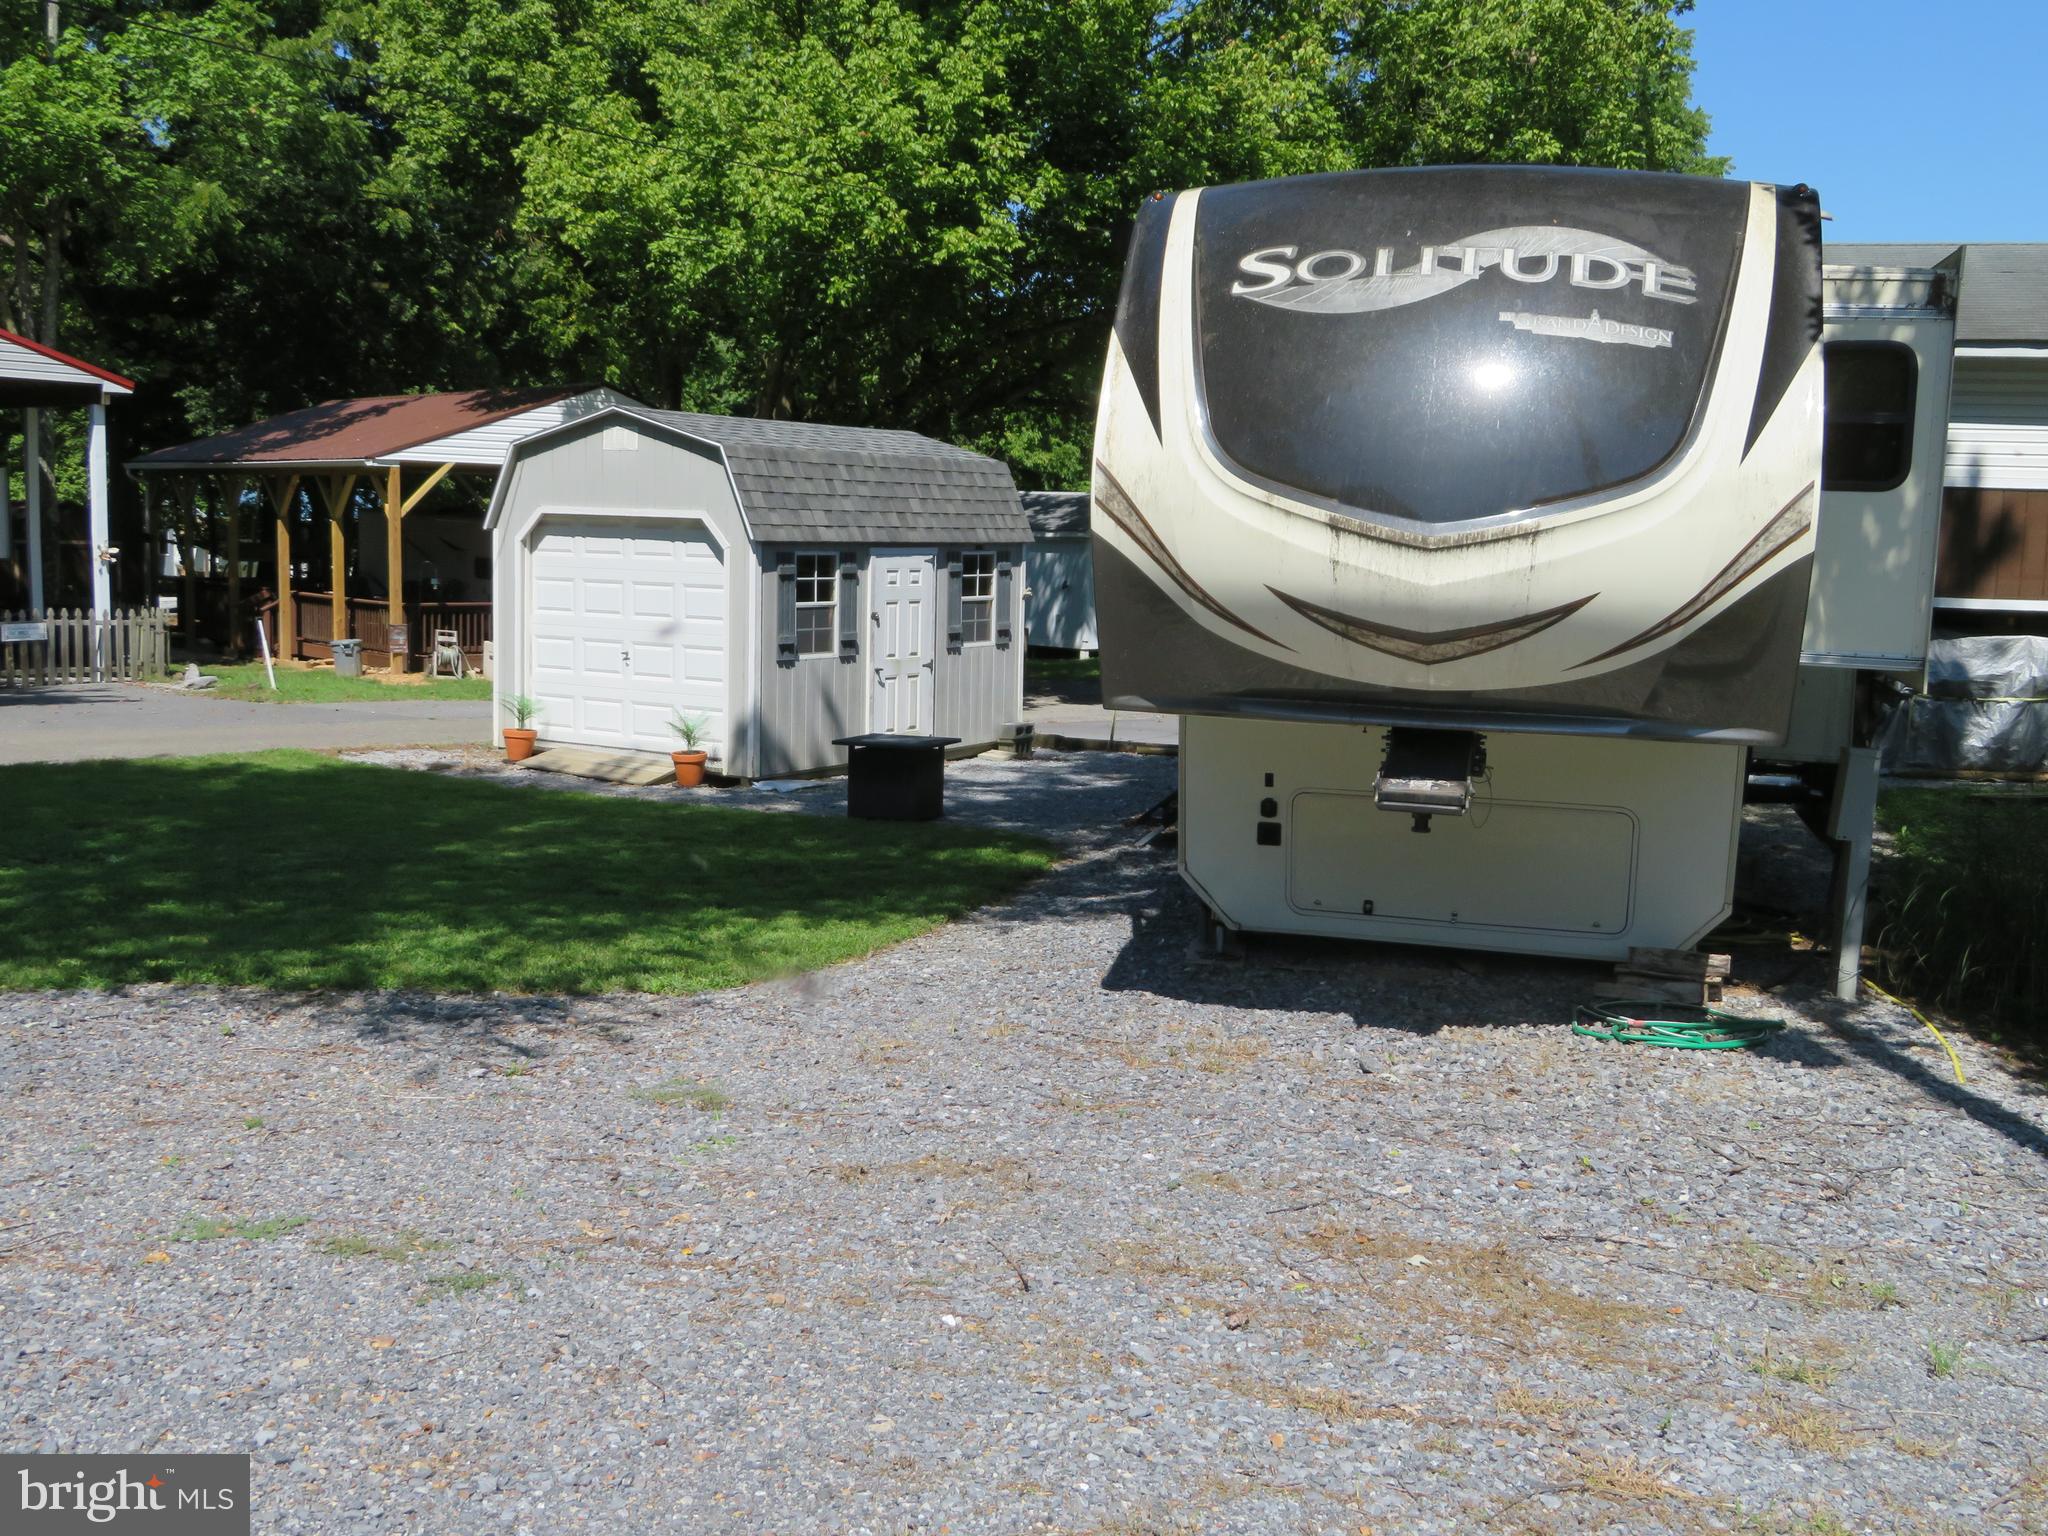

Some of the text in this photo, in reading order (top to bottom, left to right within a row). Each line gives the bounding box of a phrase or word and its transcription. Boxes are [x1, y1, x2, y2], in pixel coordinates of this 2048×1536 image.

[1231, 245, 1698, 304] SOLITUDE
[1516, 313, 1586, 331] GRAND
[1605, 320, 1673, 344] DESIGN
